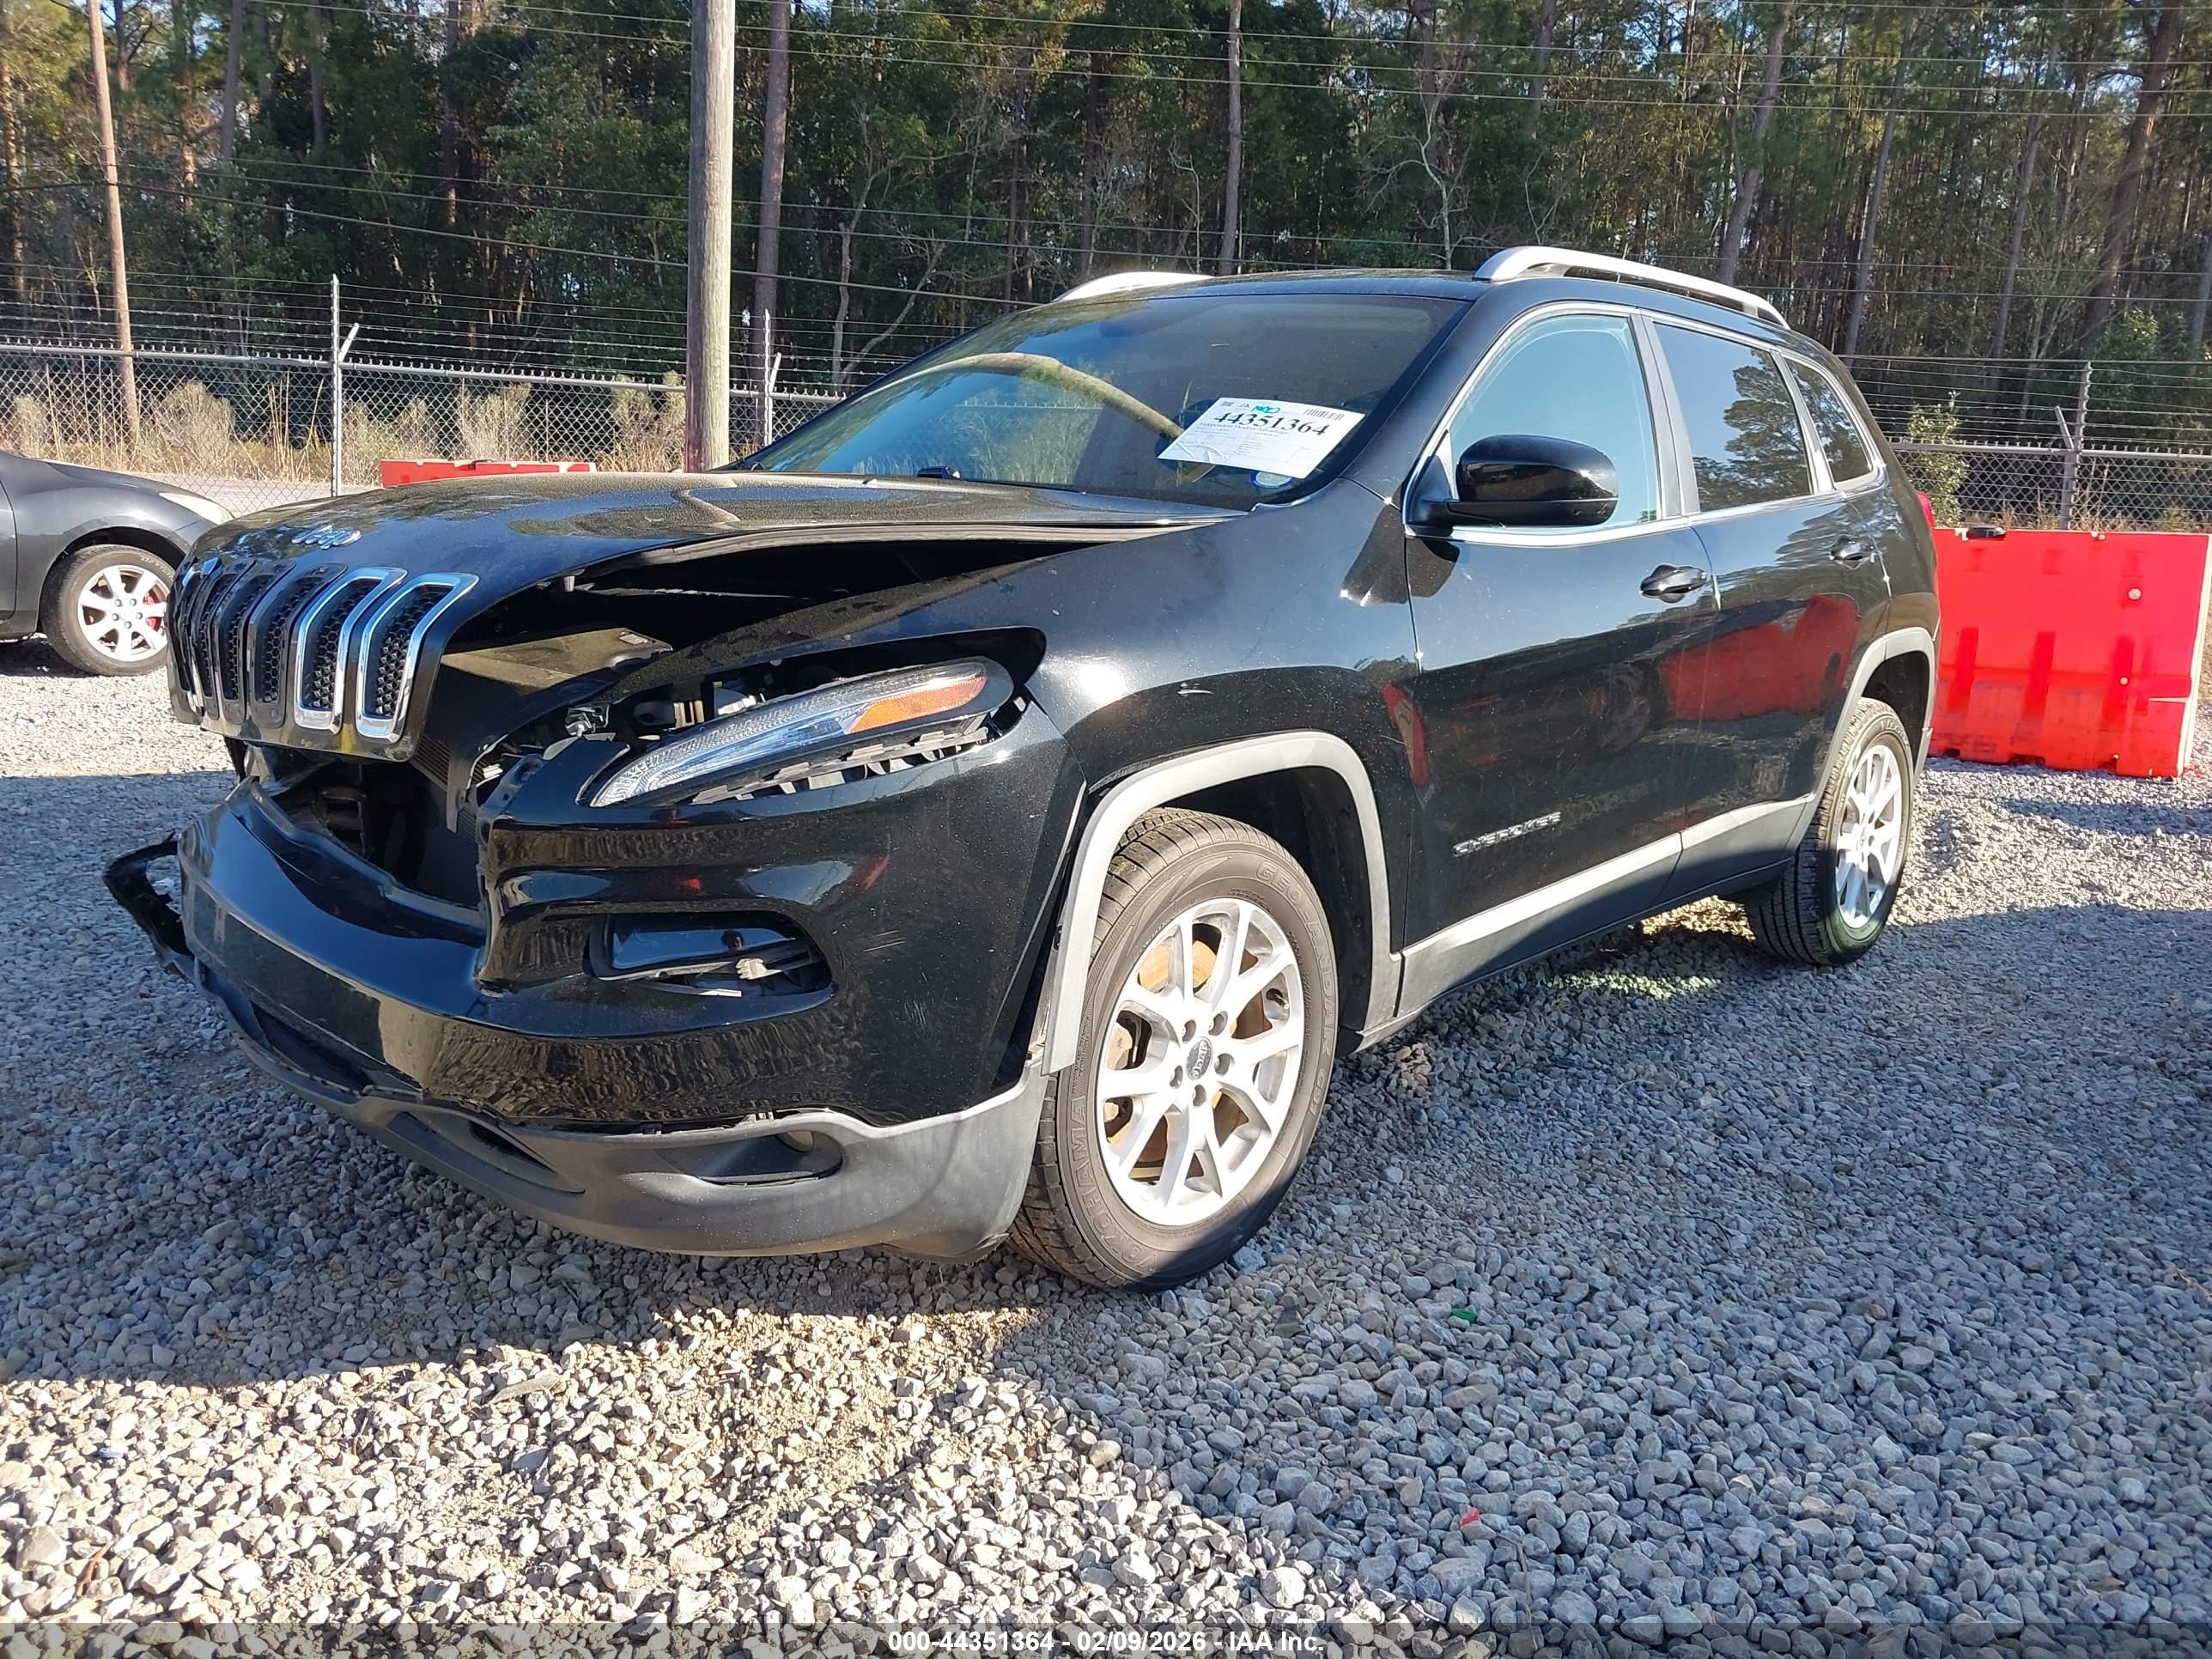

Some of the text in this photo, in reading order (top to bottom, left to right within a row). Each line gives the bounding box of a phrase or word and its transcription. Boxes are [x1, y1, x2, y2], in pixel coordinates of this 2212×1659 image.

[1214, 412, 1330, 435] 44351364
[1255, 861, 1337, 1055] GEOLANDAR
[1191, 1040, 1209, 1078] Jeep
[1070, 1097, 1158, 1275] YOKOHAMA
